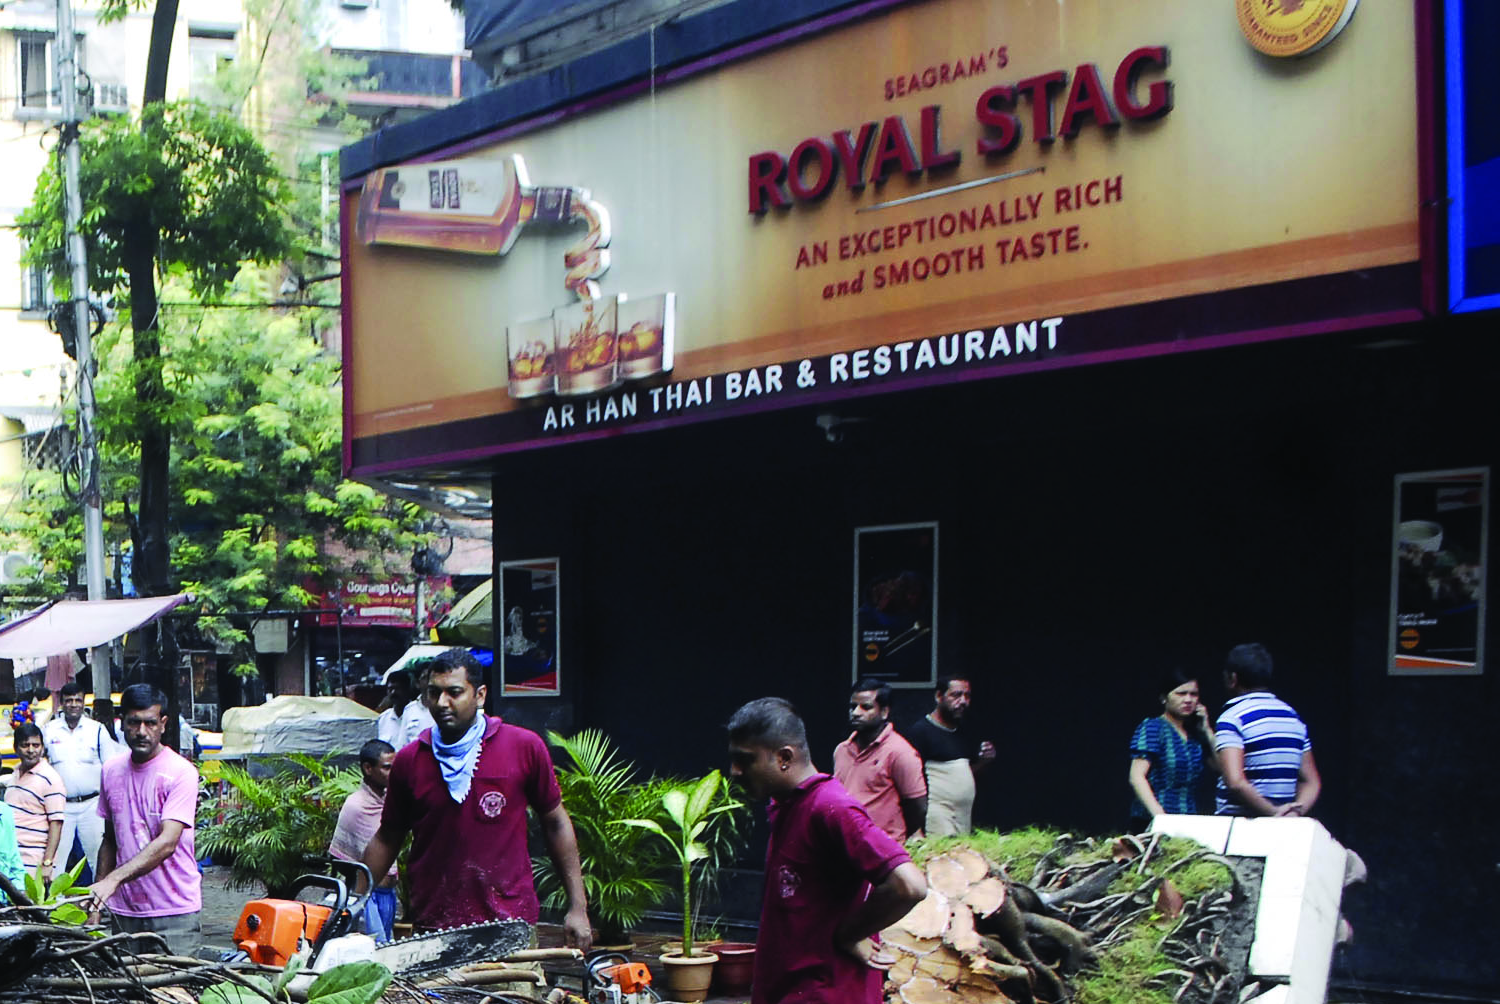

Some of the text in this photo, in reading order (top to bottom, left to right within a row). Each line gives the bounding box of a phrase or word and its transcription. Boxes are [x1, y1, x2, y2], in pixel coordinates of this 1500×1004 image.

[884, 45, 1009, 100] SEAGRAM'S
[748, 45, 1175, 216] ROYAL STAG
[795, 175, 1124, 270] AN EXCEPTIONALLY RICH
[821, 226, 1090, 301] and SMOOTH TASTE.
[542, 316, 1064, 432] AR HAN THAI BAR & RESTAURANT
